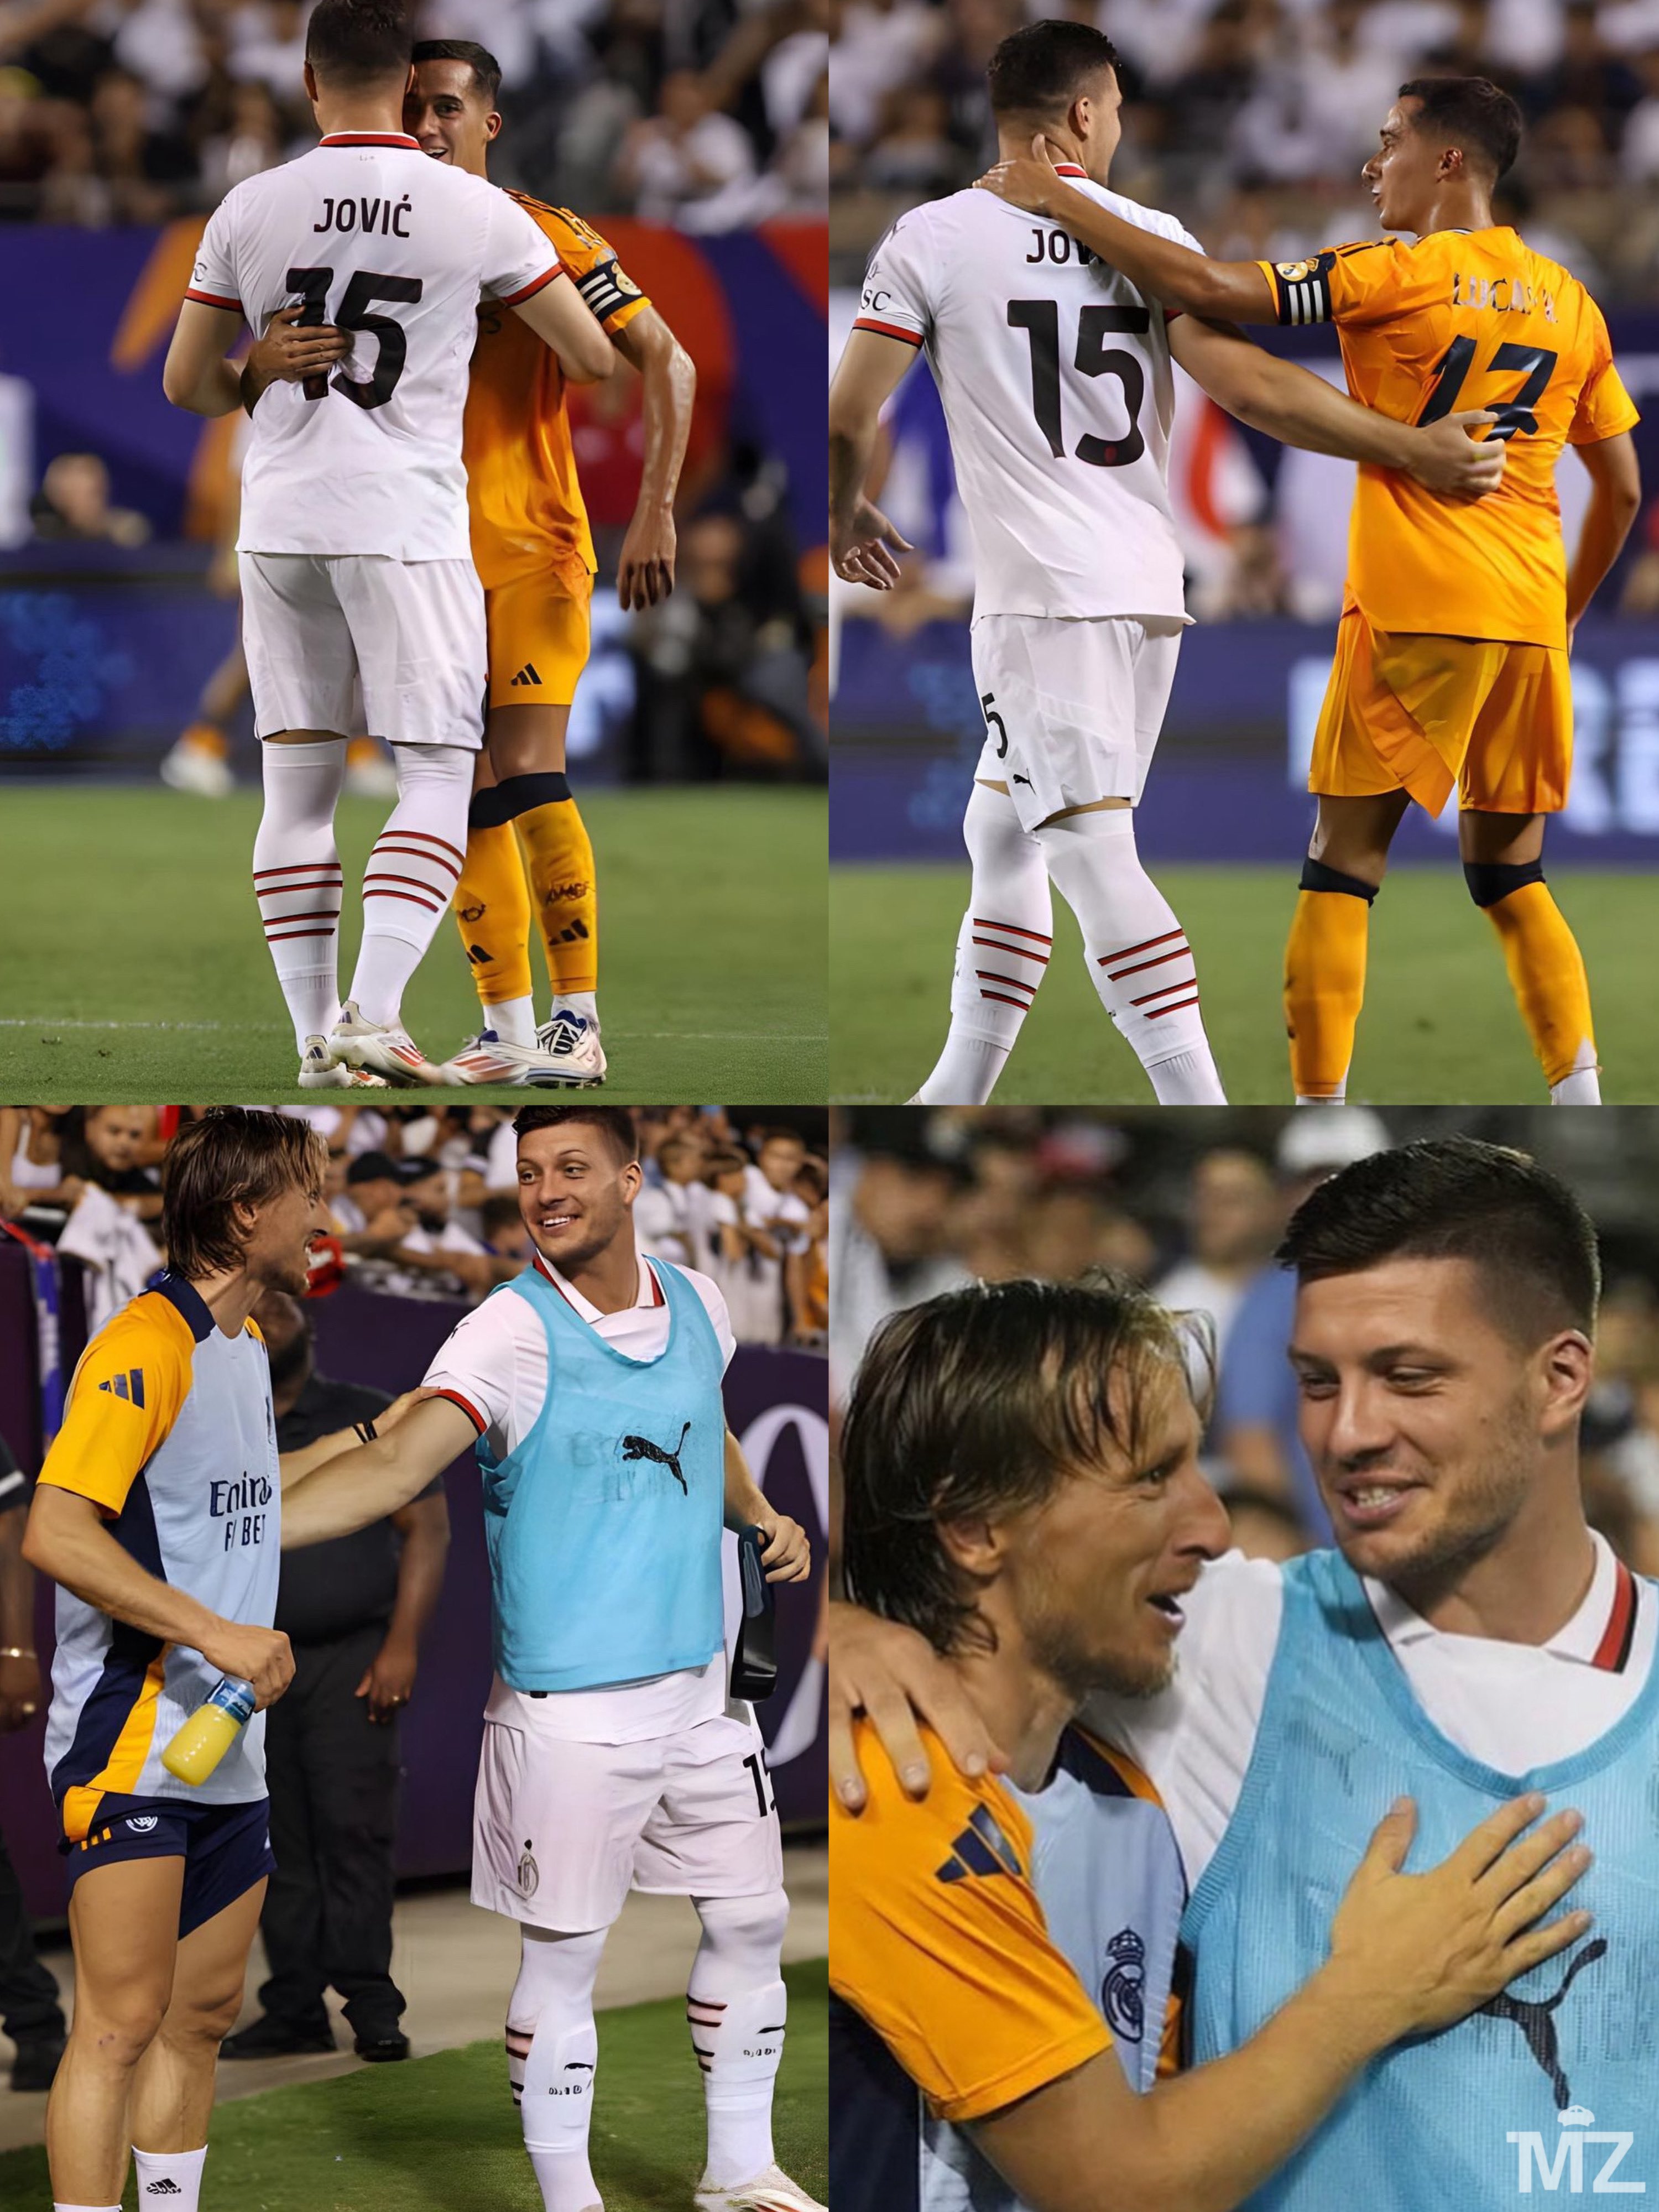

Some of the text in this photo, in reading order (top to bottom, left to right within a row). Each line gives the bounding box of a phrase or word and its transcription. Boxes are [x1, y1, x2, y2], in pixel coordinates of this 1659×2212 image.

[314, 194, 412, 238] JOVIĆ
[1026, 228, 1105, 265] JOV
[285, 267, 424, 410] 15
[1007, 299, 1150, 467] 15
[1415, 333, 1559, 443] 17
